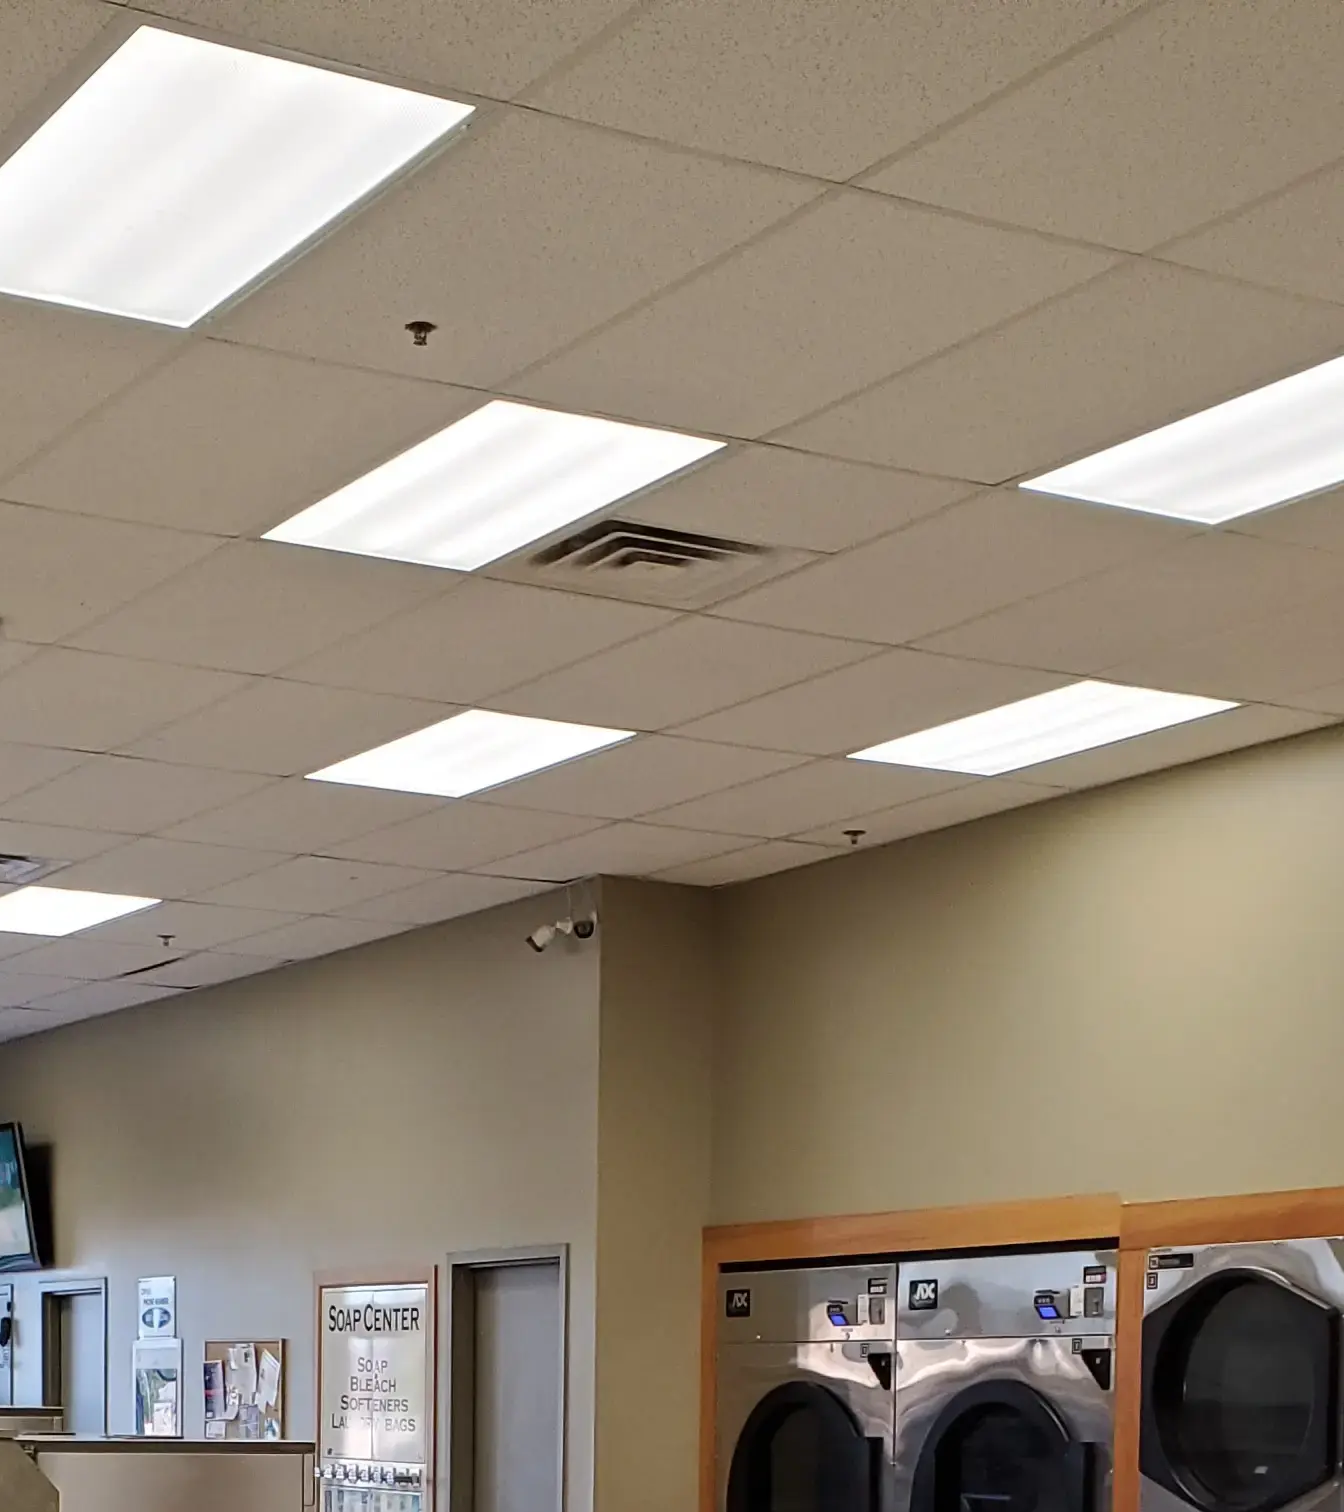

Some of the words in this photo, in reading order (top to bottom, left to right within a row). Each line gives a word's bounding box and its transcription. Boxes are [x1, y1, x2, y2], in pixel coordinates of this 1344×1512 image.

[328, 1304, 362, 1332] SOAP
[363, 1303, 420, 1332] CENTER
[357, 1357, 388, 1374] SOAP
[350, 1375, 397, 1393] BLEACH
[340, 1394, 409, 1412] SOFTENERS
[385, 1417, 416, 1432] BAGS
